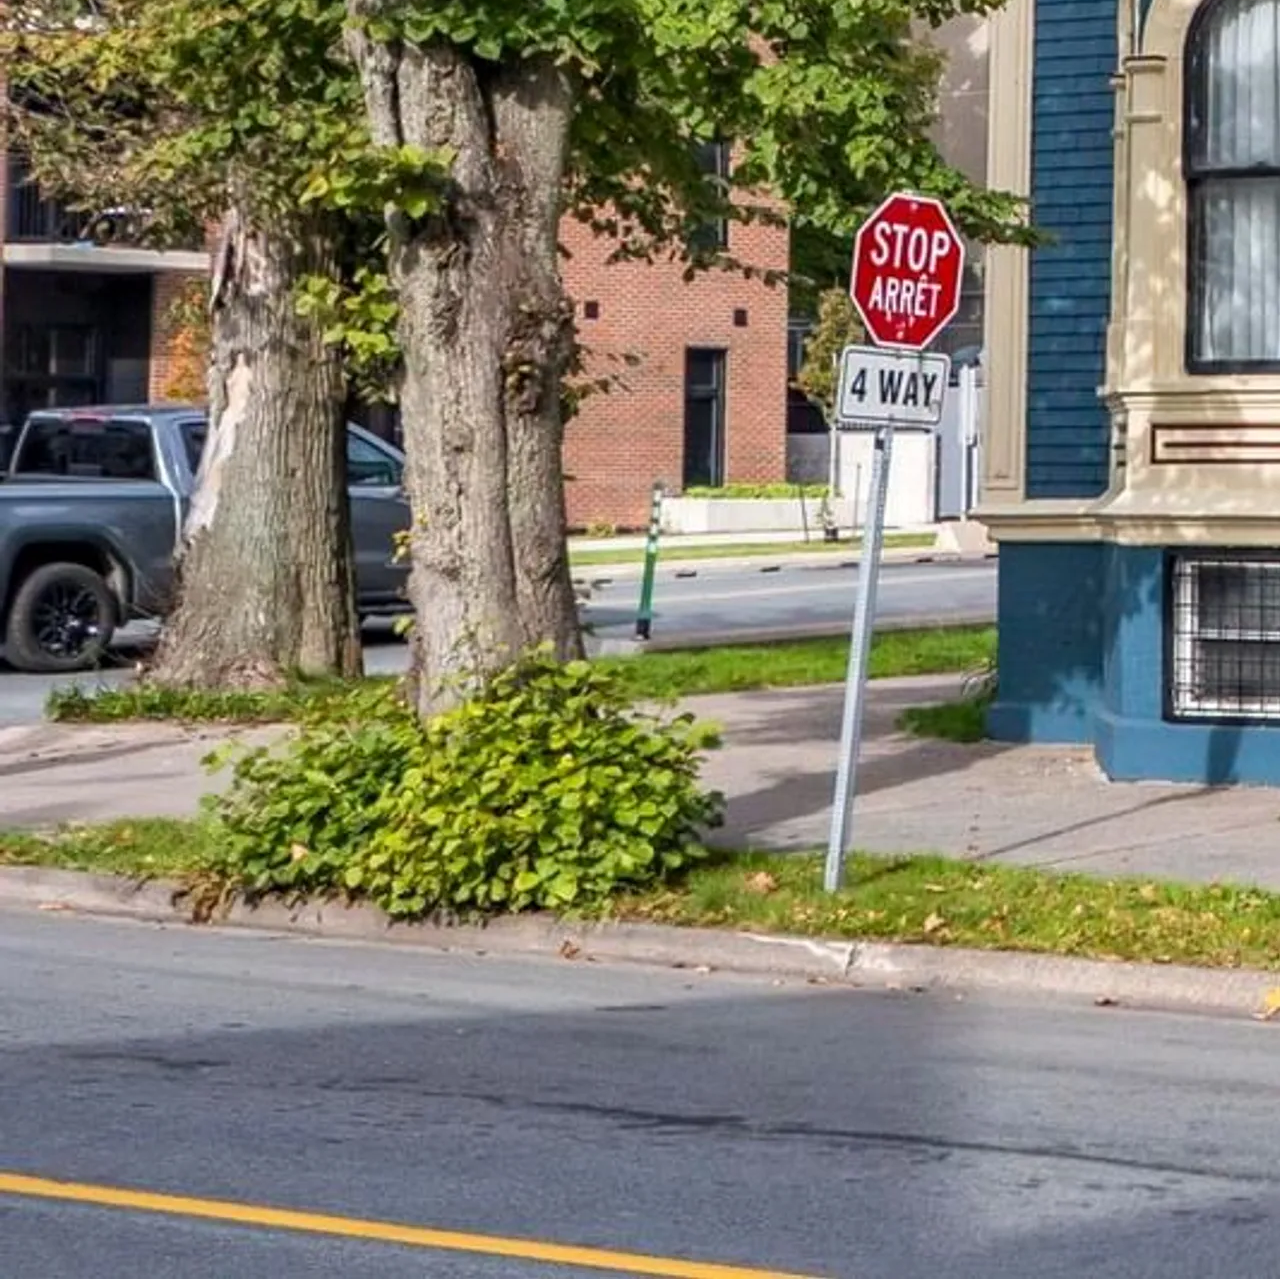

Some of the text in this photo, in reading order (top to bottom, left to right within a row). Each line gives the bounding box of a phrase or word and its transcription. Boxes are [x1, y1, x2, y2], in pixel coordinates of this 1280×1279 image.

[870, 221, 950, 274] STOP
[868, 275, 942, 318] ARRÊT
[850, 368, 937, 407] 4 WAY
